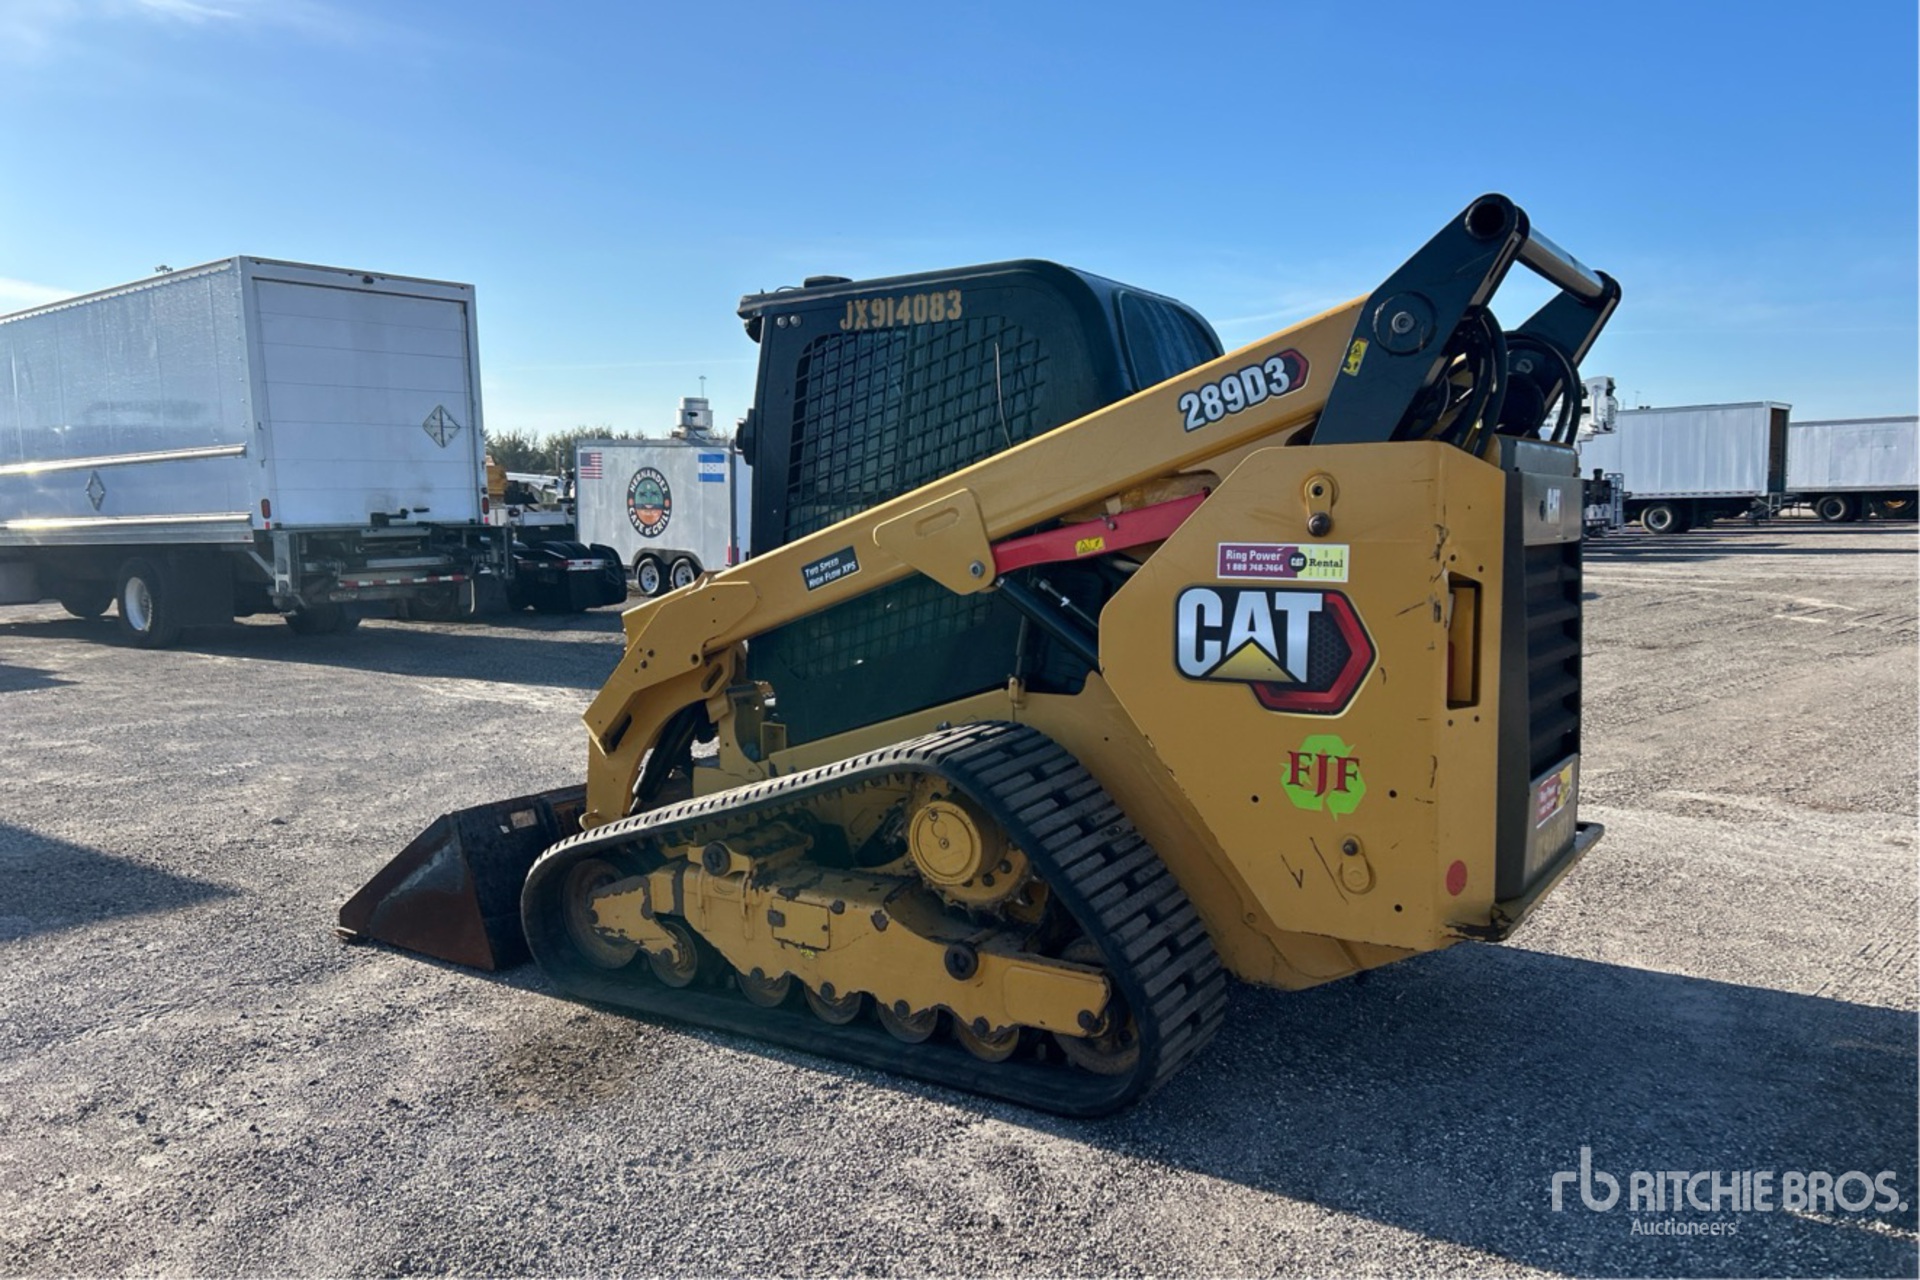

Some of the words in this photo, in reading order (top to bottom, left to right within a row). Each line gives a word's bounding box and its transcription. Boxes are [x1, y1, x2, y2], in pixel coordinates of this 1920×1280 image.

[840, 289, 962, 330] JX914083
[1179, 357, 1290, 430] 289D3
[630, 470, 668, 494] HERNANDEZ
[653, 509, 670, 534] GRILL
[842, 560, 857, 574] XPS
[1226, 549, 1247, 562] Ring
[1249, 550, 1281, 561] Power
[1226, 563, 1231, 571] 1
[1232, 563, 1247, 571] 888
[1290, 558, 1304, 567] CAT
[1309, 558, 1343, 568] Rental
[1178, 587, 1323, 683] CAT
[1286, 750, 1360, 797] FJF
